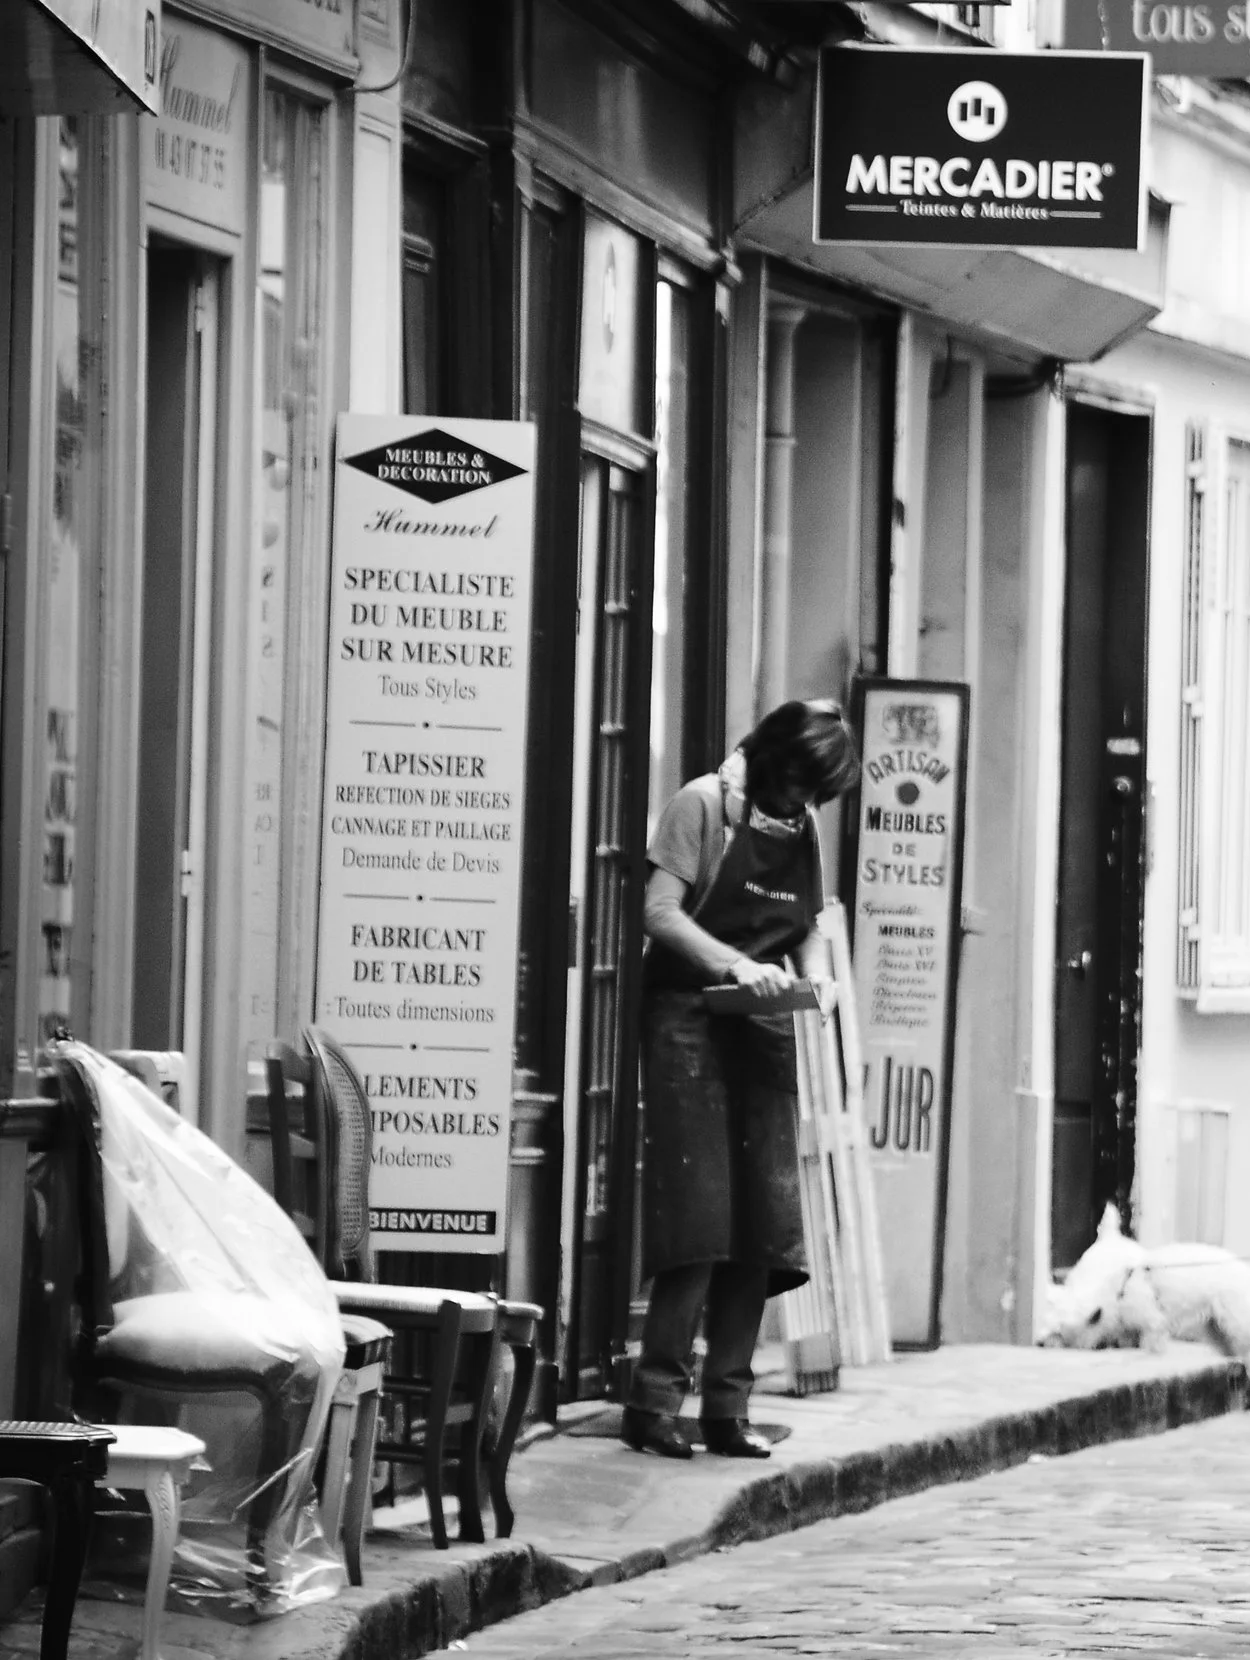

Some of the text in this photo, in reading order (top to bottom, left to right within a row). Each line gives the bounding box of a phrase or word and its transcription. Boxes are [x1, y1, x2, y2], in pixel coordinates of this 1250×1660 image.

[900, 199, 958, 218] Teintes
[961, 202, 976, 218] &
[385, 449, 486, 468] MEUBLES &
[377, 464, 492, 485] DECORATION
[363, 507, 499, 538] Hummel
[344, 567, 515, 598] SPECIALISTE
[350, 603, 508, 633] DU MEUBLE
[341, 636, 513, 669] SUR MESURE
[378, 674, 477, 704] Tous Styles
[362, 751, 487, 779] TAPISSIER
[866, 750, 950, 784] ARTISAN
[335, 784, 511, 811] REFECTION DE SIEGES
[331, 816, 512, 843] CANNAGE ET PAILLAGE
[865, 806, 946, 834] MEUBLES
[341, 847, 501, 874] Demande de Devis
[862, 858, 945, 886] STYLES
[744, 880, 797, 902] MERDIER
[350, 924, 486, 952] FABRICANT
[878, 924, 935, 939] MEUBLES
[353, 960, 481, 986] DE TABLES
[335, 996, 494, 1023] Toutes dimensions
[371, 1110, 499, 1136] POSABLES
[370, 1211, 488, 1232] BIENVENUE
